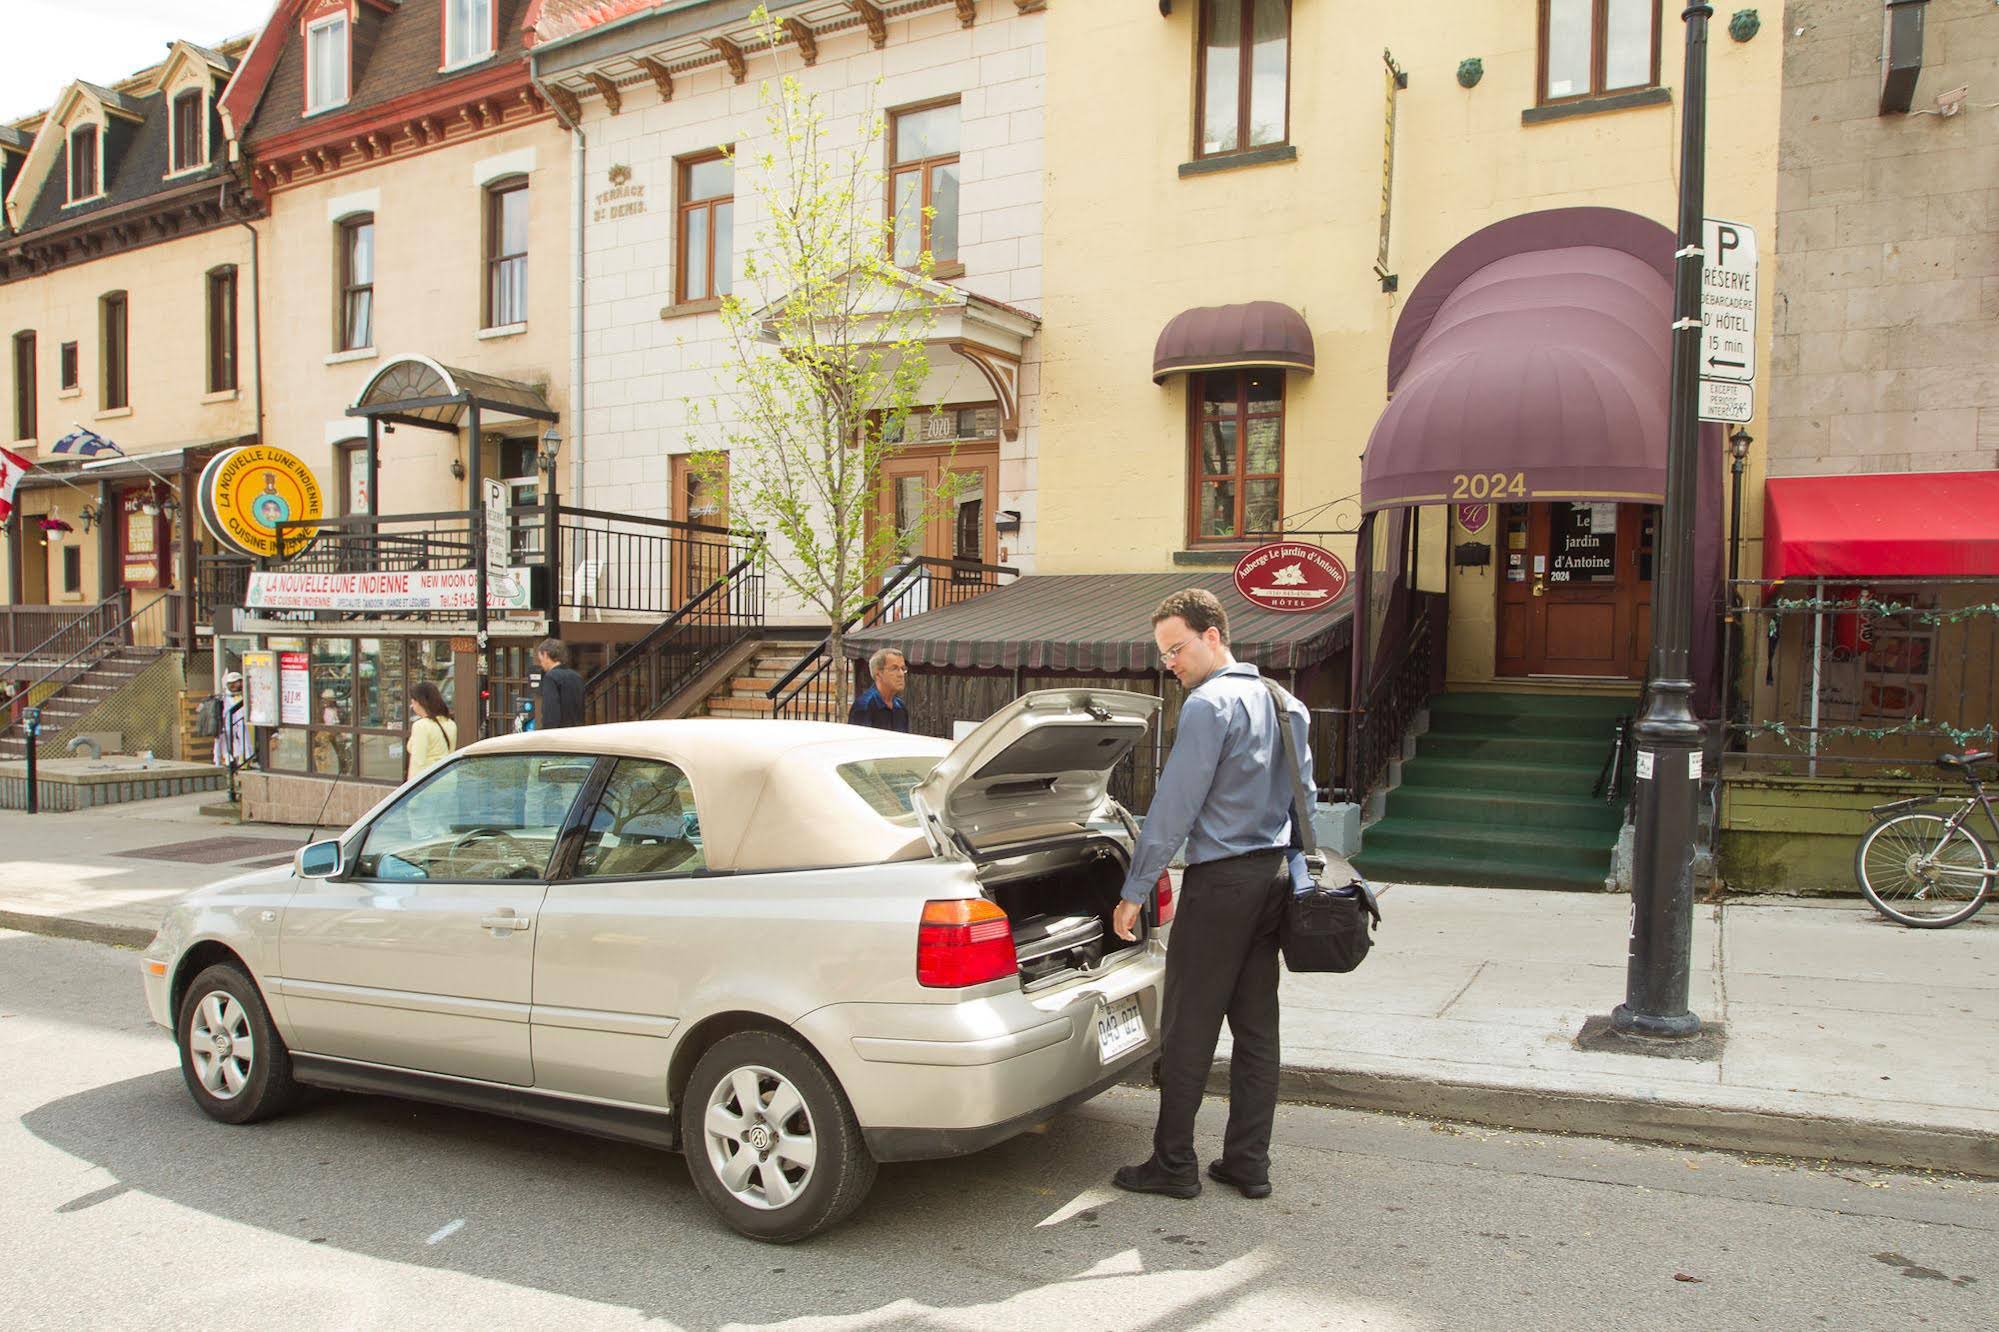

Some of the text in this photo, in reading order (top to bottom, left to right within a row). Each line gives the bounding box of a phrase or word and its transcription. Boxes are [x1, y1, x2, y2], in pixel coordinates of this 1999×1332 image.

[1718, 226, 1739, 266] P
[1704, 267, 1750, 291] RÉSERVÉ
[1716, 312, 1748, 332] HÔTEL
[1709, 336, 1719, 350] 15
[928, 418, 949, 437] 2020
[220, 450, 318, 515] LA NOUVELLE LUNE INDIENNE
[1452, 472, 1526, 498] 2024
[492, 485, 500, 508] P
[1576, 514, 1590, 526] Le
[229, 518, 267, 550] CUISINE
[1565, 535, 1600, 551] jardin
[1238, 547, 1342, 581] Auberge Le jardin d'Antoine
[1554, 555, 1610, 568] d'Antoine
[266, 575, 408, 593] LA NOUVELLE LUNE INDIENNE
[421, 575, 438, 588] NEW
[441, 574, 466, 588] MOON
[1551, 571, 1570, 581] 2024
[303, 597, 331, 607] INDIENNE
[1099, 1016, 1119, 1045] 043
